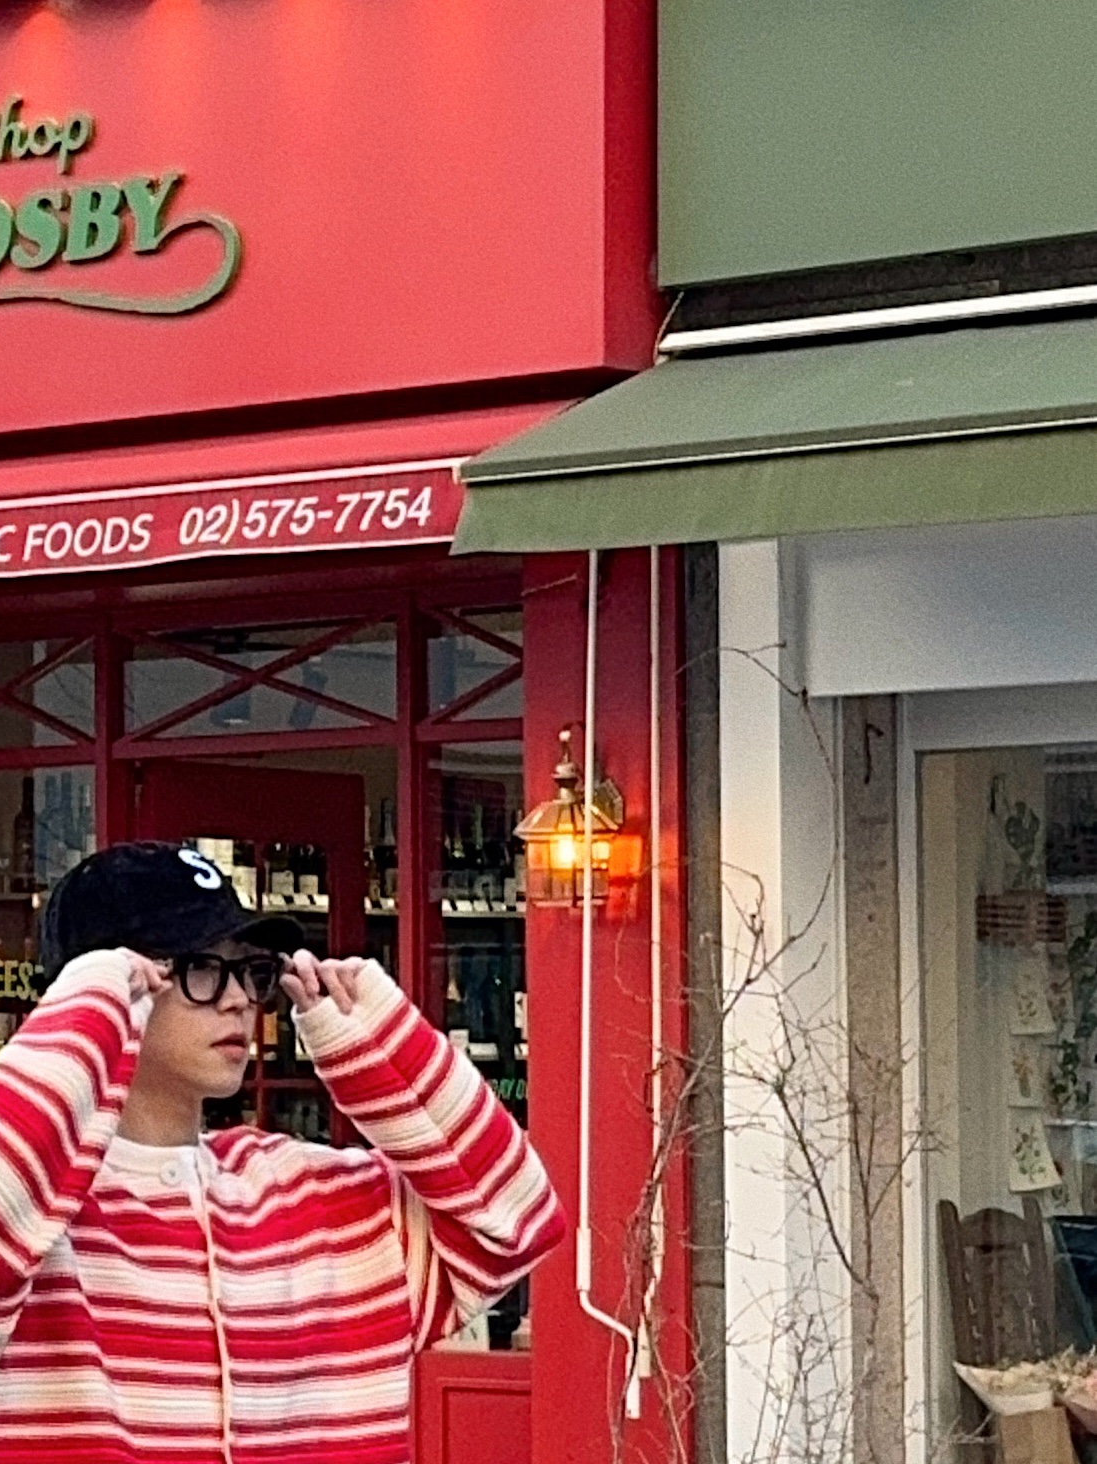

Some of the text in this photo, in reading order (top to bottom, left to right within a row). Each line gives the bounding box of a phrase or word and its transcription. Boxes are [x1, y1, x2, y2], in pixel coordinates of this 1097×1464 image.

[22, 512, 154, 562] FOODS
[178, 486, 433, 546] 02)575-7754
[177, 848, 222, 890] S
